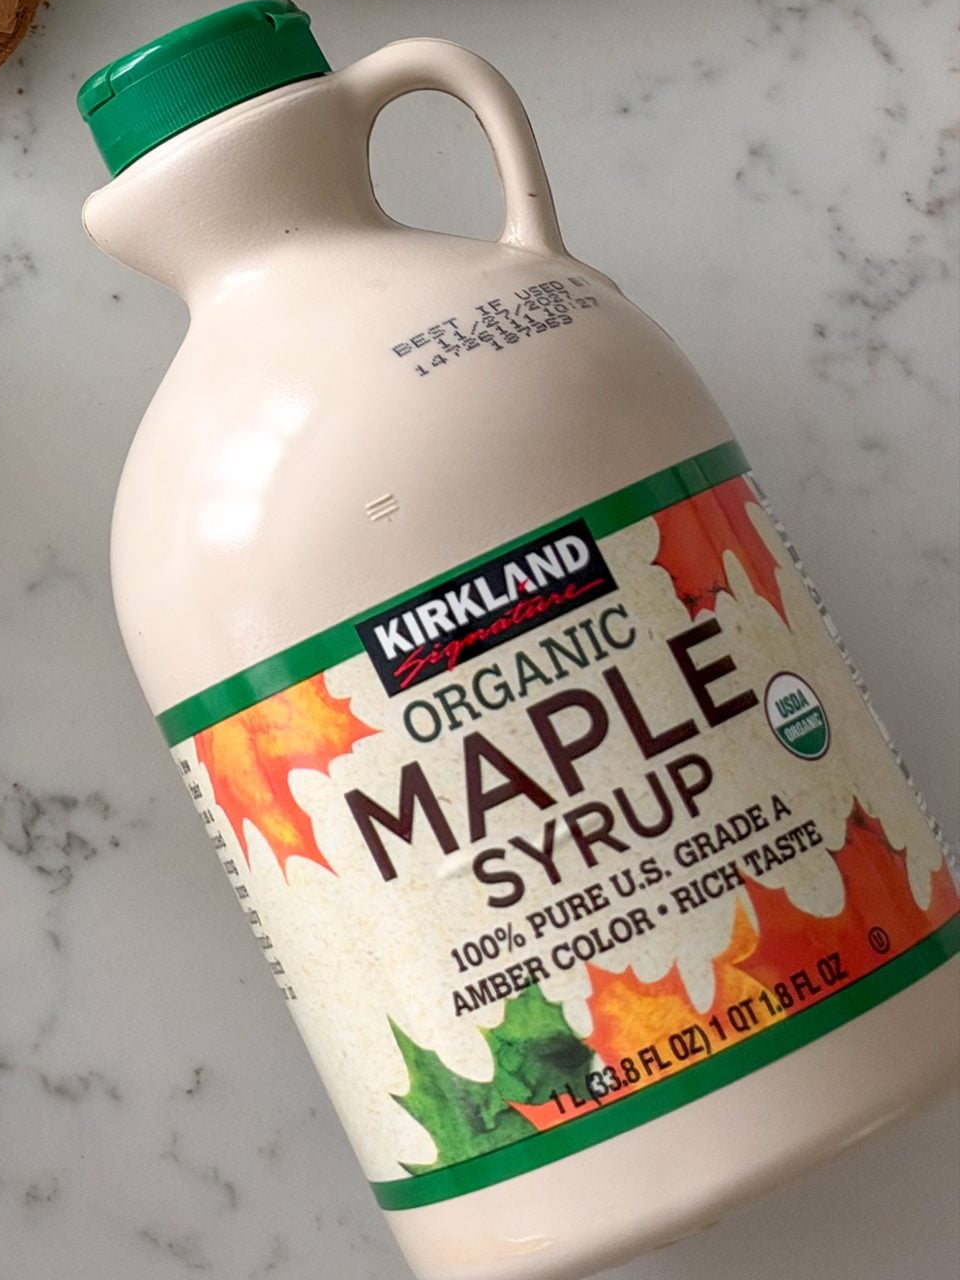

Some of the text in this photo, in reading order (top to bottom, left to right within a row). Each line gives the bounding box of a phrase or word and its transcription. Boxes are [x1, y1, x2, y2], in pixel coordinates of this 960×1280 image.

[392, 317, 458, 358] BEST
[475, 298, 503, 316] IF
[514, 280, 564, 301] USED
[374, 535, 590, 660] KIRKLAND
[394, 578, 605, 689] Signature
[403, 603, 636, 743] ORGANIC
[775, 688, 810, 718] USDA
[783, 711, 823, 742] ORGANIC
[344, 617, 760, 882] MAPLE
[451, 794, 791, 972] 100% PURE U.S. GRADE A
[472, 753, 713, 908] SYRUP
[452, 820, 823, 1017] AMBER COLOR RICH TASTE
[549, 952, 848, 1114] 1 L (33.8 FL OZ) 1 QT 1.8 FL OZ
